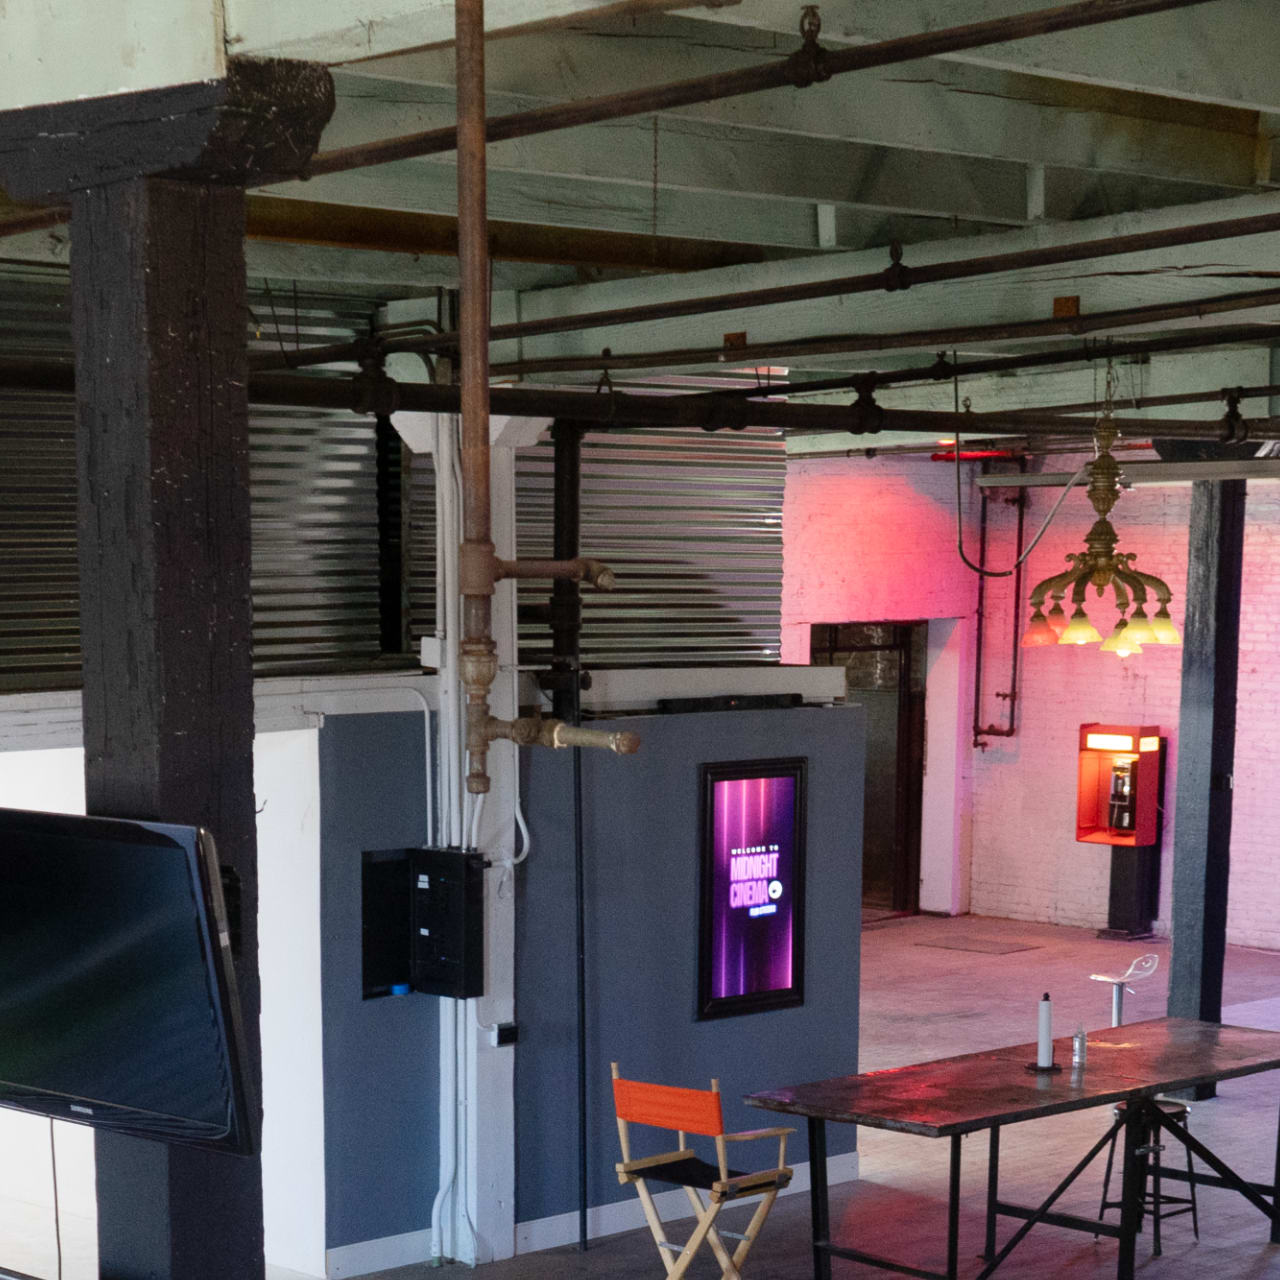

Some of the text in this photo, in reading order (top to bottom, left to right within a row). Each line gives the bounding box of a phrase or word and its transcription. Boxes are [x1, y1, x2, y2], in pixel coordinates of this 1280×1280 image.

[731, 846, 766, 855] WELCOME
[731, 853, 779, 881] MIDNIGHT
[730, 880, 769, 908] CINEMA
